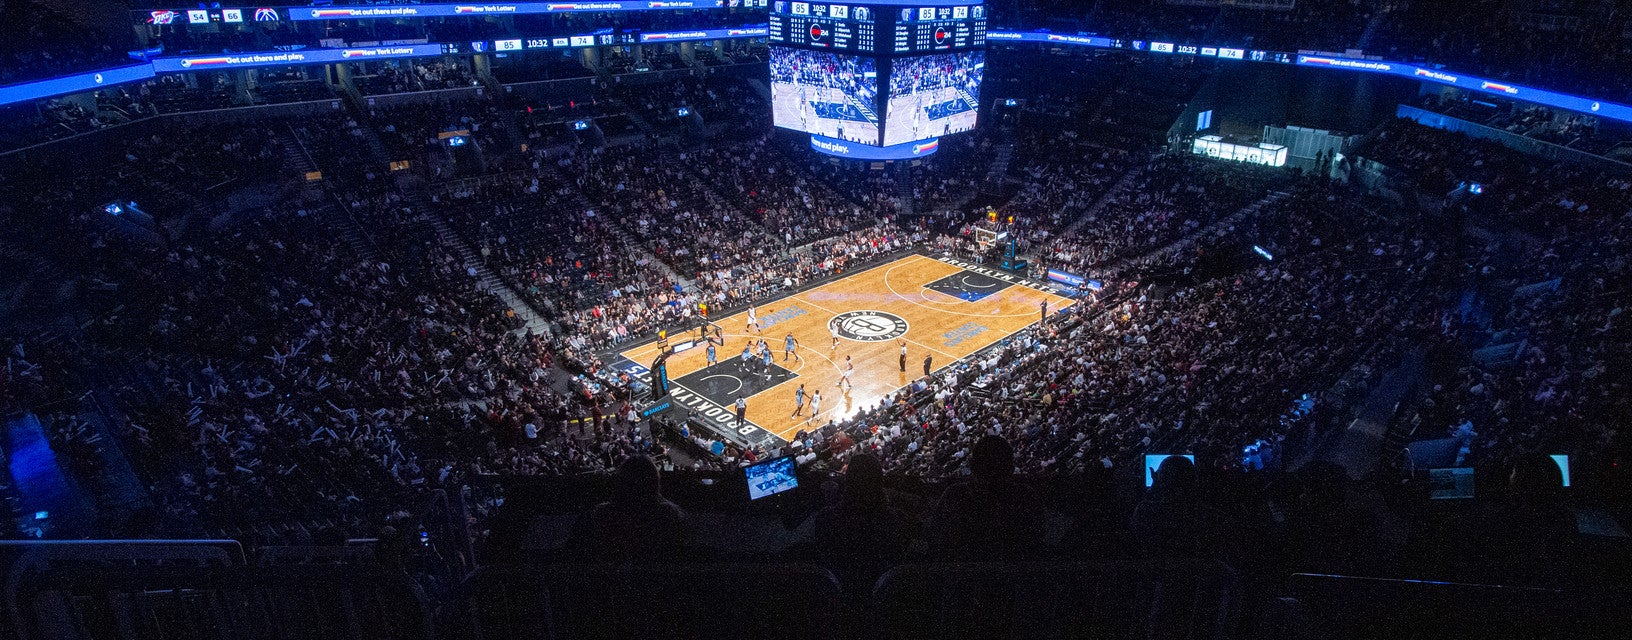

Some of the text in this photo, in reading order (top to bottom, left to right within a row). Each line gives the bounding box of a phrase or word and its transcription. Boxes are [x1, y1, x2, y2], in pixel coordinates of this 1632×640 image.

[796, 4, 805, 13] 85
[834, 7, 843, 16] 74
[957, 8, 964, 17] 74
[923, 9, 932, 18] 85
[527, 40, 548, 48] 10:32
[1178, 45, 1197, 54] 10:32
[821, 142, 832, 150] and
[832, 143, 848, 154] play.
[938, 258, 1014, 282] BROOKLYN
[1017, 279, 1060, 294] NETS
[650, 402, 670, 414] BARCLAYS
[669, 387, 758, 436] BROOKLYN
